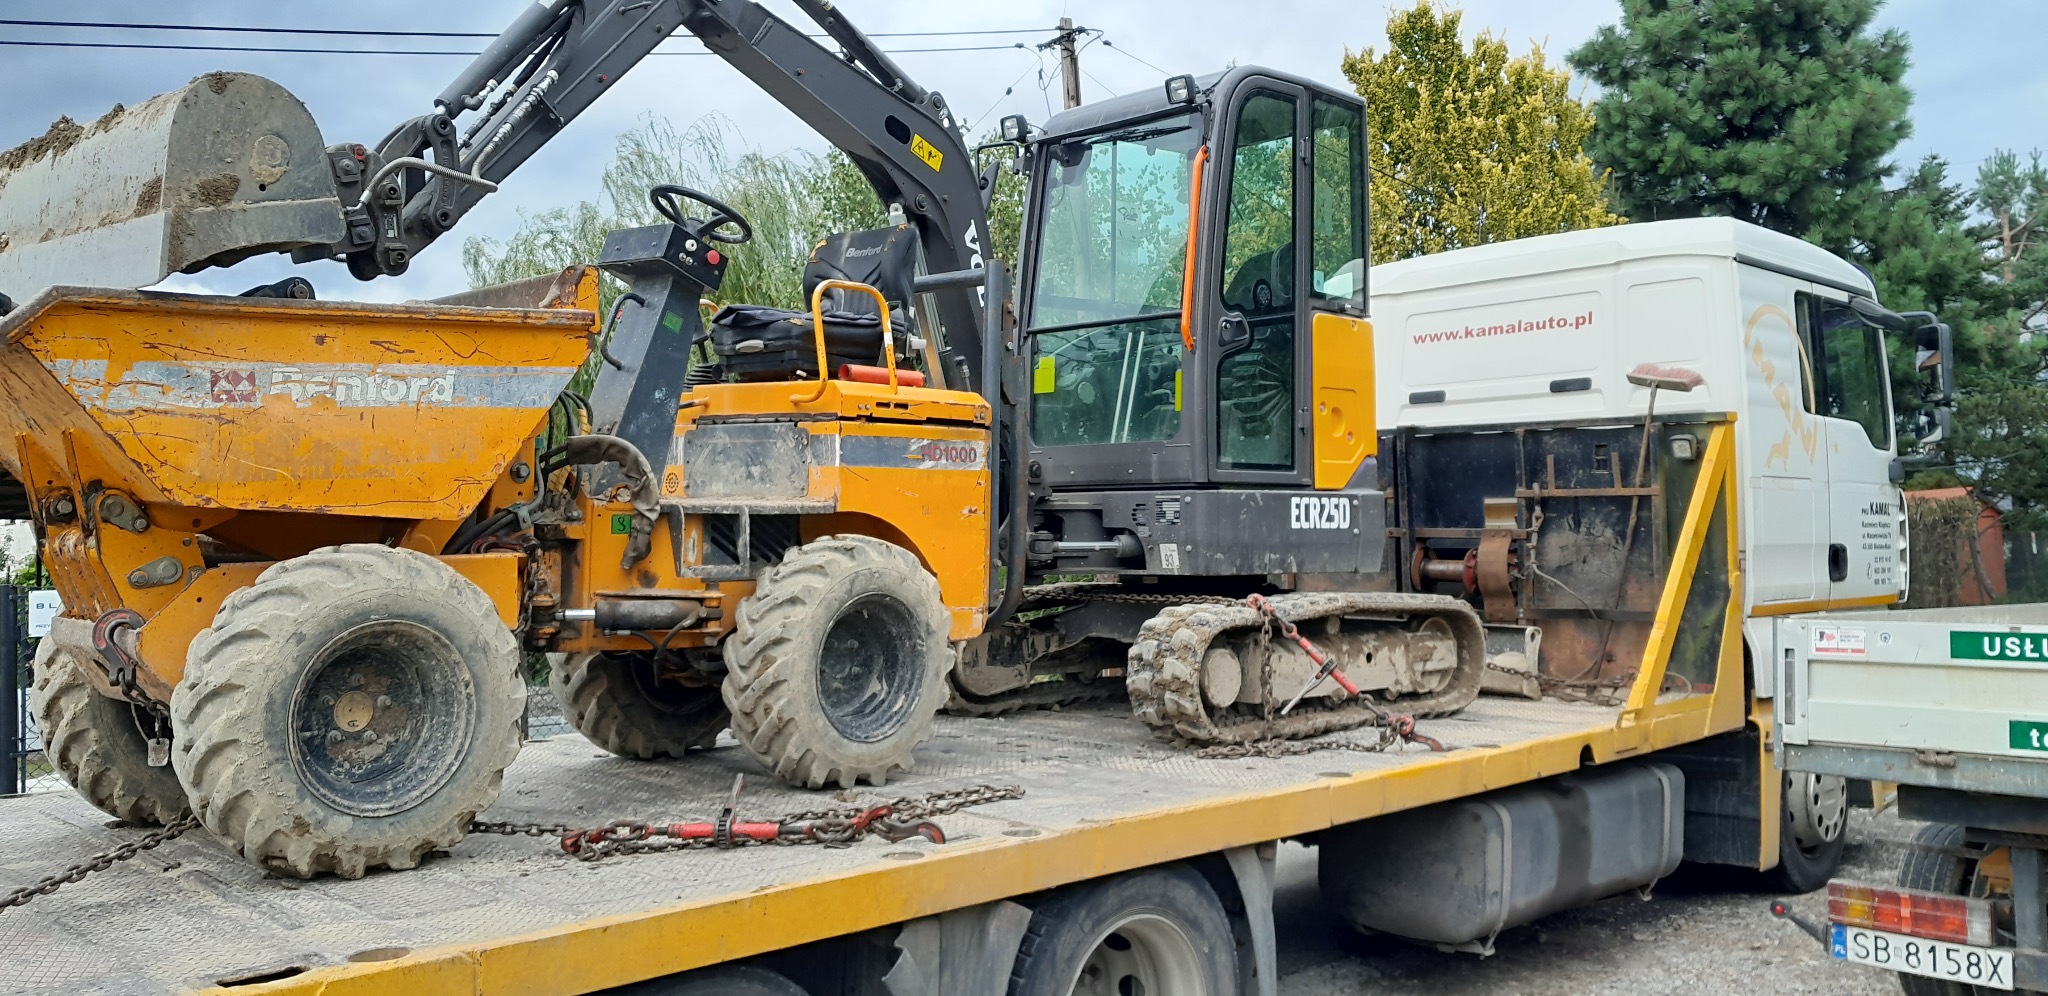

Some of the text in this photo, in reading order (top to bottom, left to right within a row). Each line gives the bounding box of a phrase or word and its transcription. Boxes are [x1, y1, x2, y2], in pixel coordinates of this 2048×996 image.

[845, 243, 883, 258] Benford
[964, 219, 985, 307] VOL
[1412, 310, 1594, 346] www.kamalauto.pl
[920, 445, 978, 463] HD1000
[1289, 496, 1351, 530] ECR25D
[1869, 501, 1891, 516] KAMAL
[36, 602, 58, 610] BL
[1834, 944, 1846, 955] PL
[1853, 932, 2004, 985] SB 8158X
